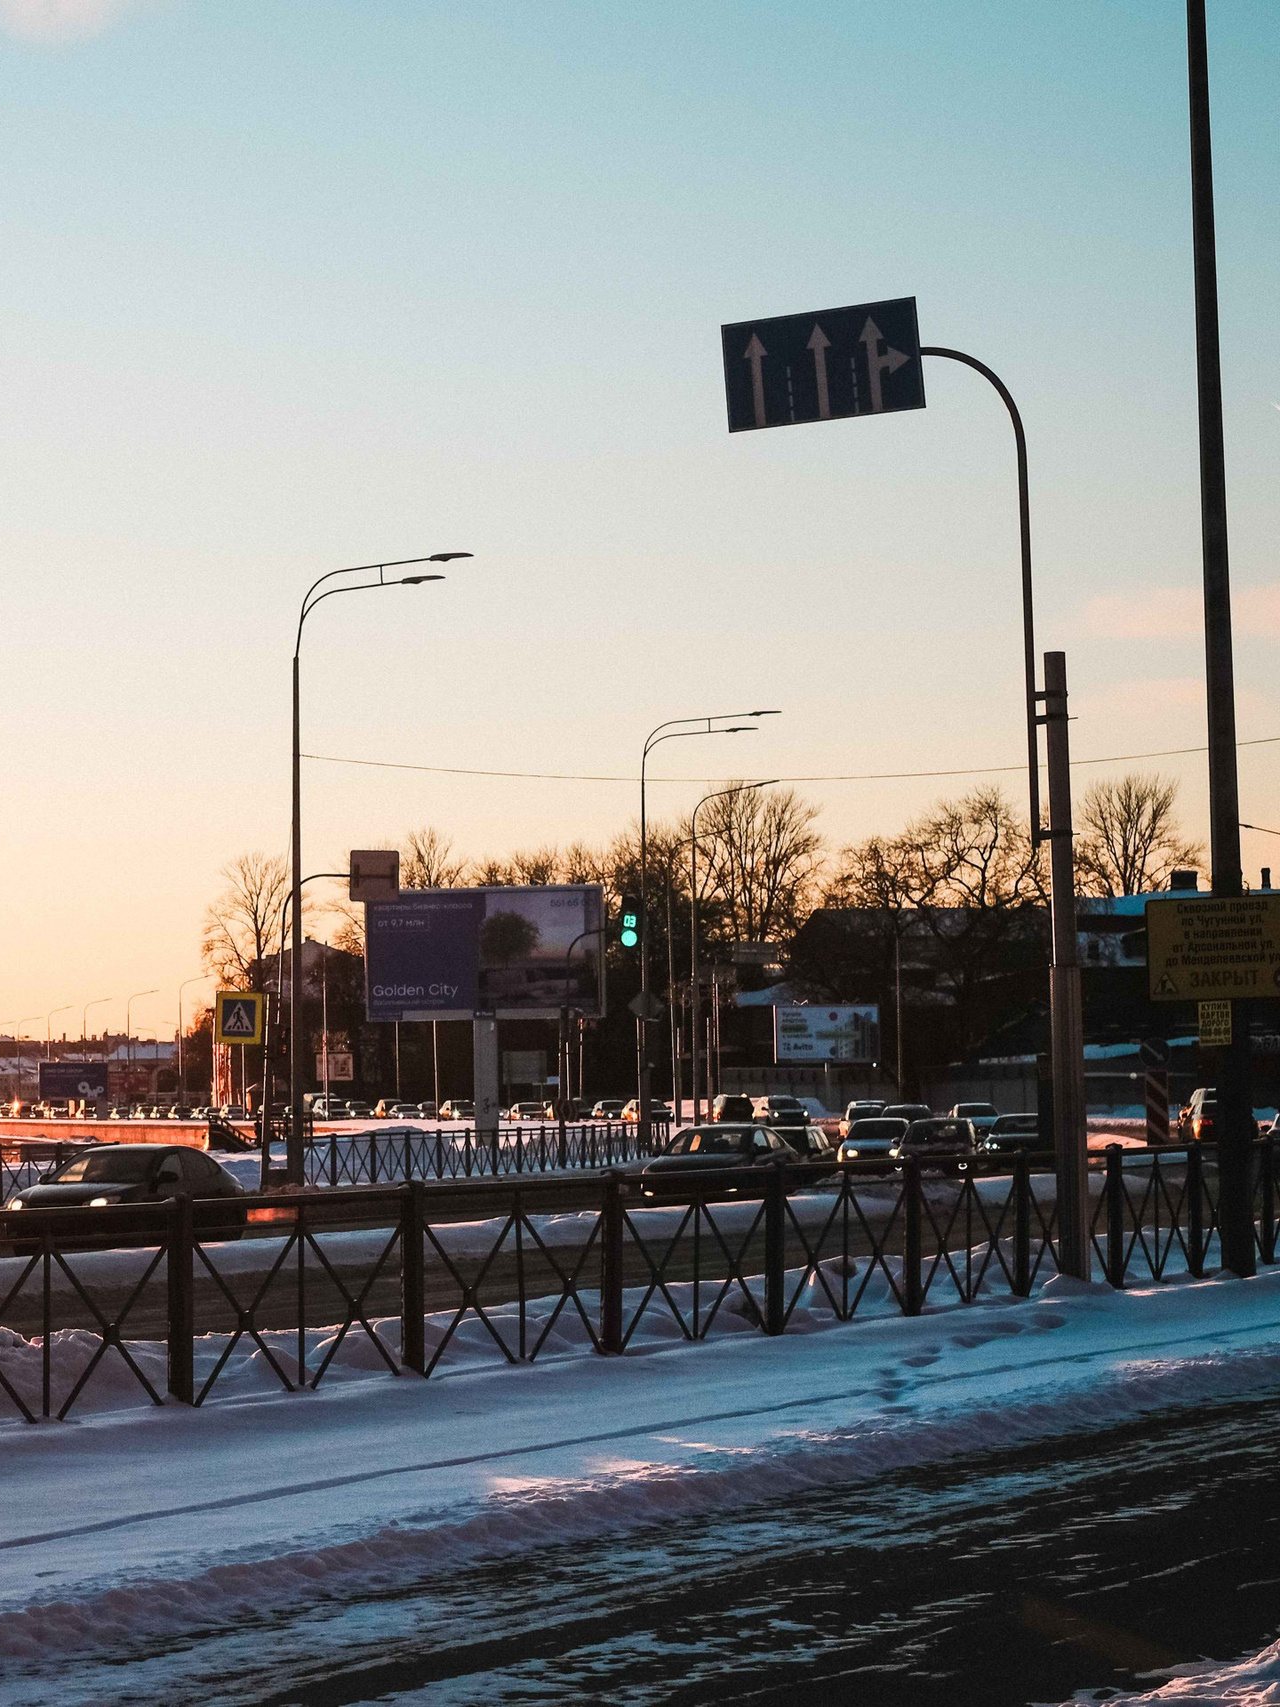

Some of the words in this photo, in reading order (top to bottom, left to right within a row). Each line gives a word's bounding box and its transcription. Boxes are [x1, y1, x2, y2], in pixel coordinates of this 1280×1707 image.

[1177, 902, 1226, 914] Сквозной
[1230, 901, 1268, 913] проезд
[623, 914, 637, 928] 03
[1181, 918, 1194, 926] по
[1197, 914, 1246, 927] Чугунной
[1249, 914, 1265, 925] ул.
[1183, 931, 1190, 939] в
[1193, 927, 1263, 940] направлении
[1172, 944, 1183, 953] от
[1187, 940, 1257, 953] Арсенальной
[1260, 940, 1275, 951] ул.
[1166, 957, 1178, 968] до
[1181, 952, 1266, 966] Менделеевской
[1189, 969, 1259, 987] ЗАКРЫТ
[372, 984, 425, 997] Golden
[428, 982, 459, 998] City
[1201, 1002, 1229, 1011] КУПИМ
[1202, 1018, 1229, 1028] ДОРОГО
[793, 1043, 813, 1051] Avito
